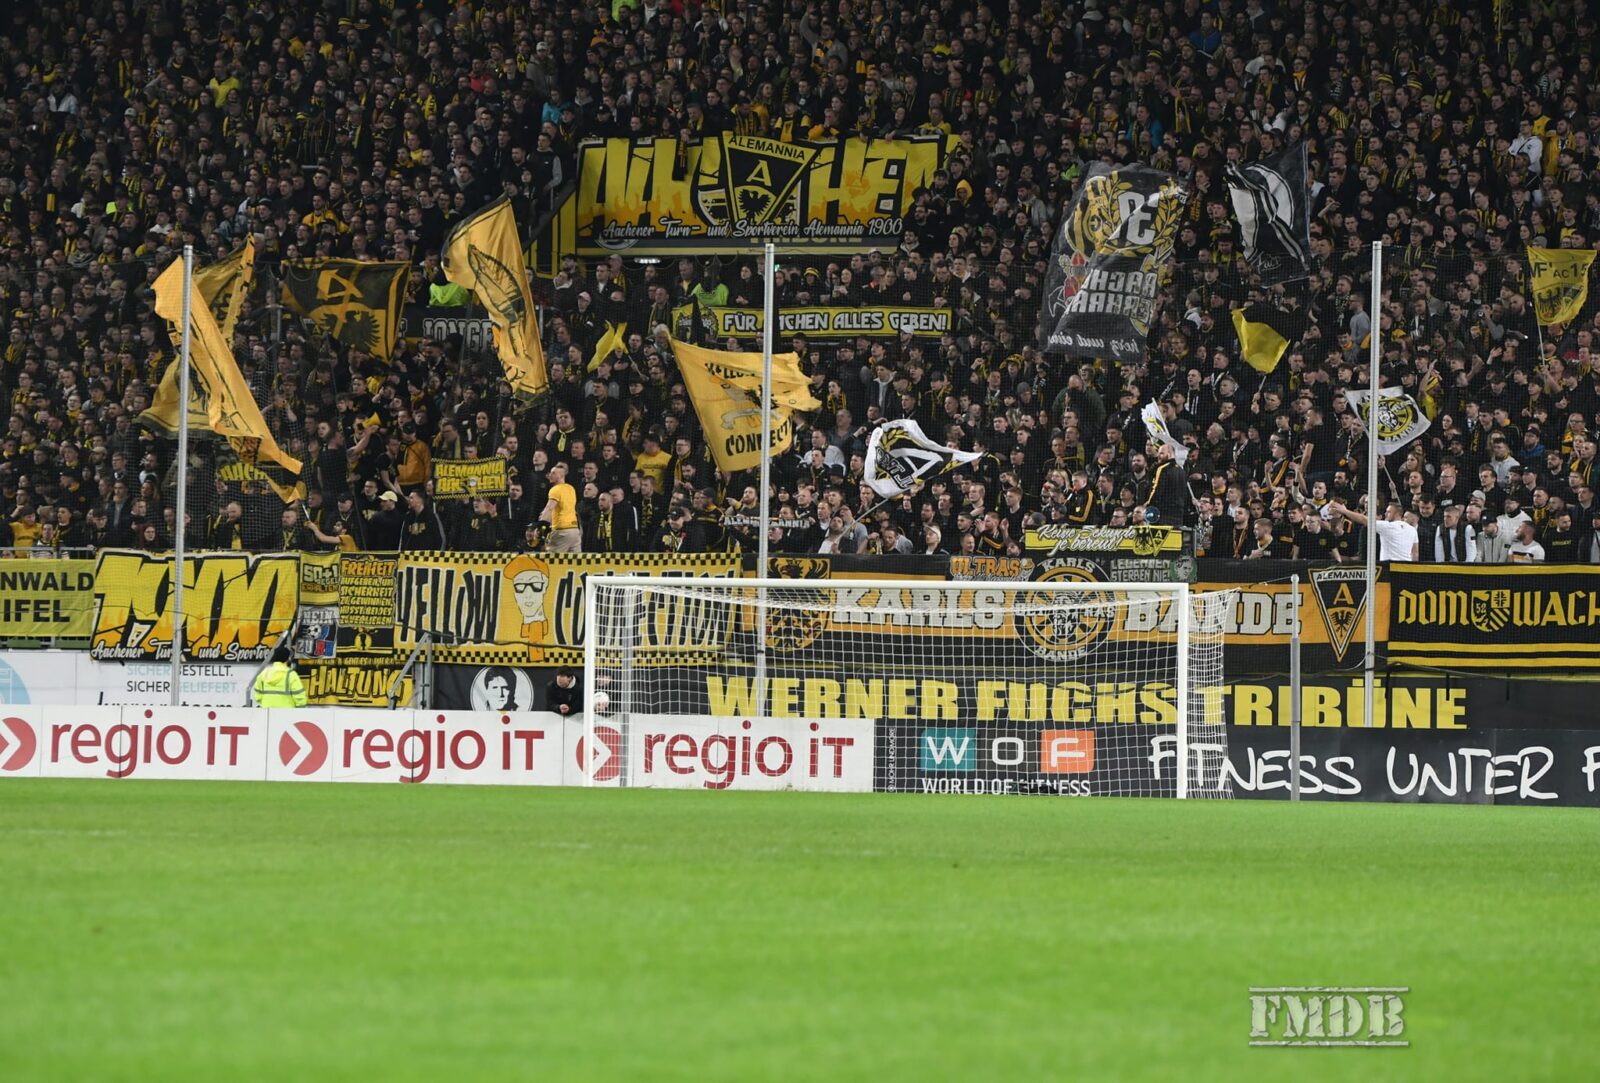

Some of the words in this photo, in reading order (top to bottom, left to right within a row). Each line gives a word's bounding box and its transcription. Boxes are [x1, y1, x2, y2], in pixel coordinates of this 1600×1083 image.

[728, 136, 806, 161] ALEMANNIA
[746, 159, 772, 187] A
[603, 220, 656, 238] Aachener
[659, 217, 700, 238] Turn-
[707, 221, 730, 238] und
[732, 219, 800, 240] Sportverein
[803, 218, 865, 237] Alemannia
[868, 217, 903, 236] 1900
[723, 311, 758, 331] FÜR
[832, 312, 884, 330] ALLES
[889, 312, 948, 331] GEBEN!
[1037, 525, 1075, 540] Keine
[1077, 525, 1136, 541] Sekunde
[341, 560, 395, 576] FREIHEIT
[951, 556, 1022, 577] ULTRAS
[1042, 557, 1097, 573] KARLS
[398, 566, 501, 644] YELLOW
[1333, 582, 1353, 605] A
[302, 610, 335, 625] NEIN
[831, 587, 1006, 629] KARLS
[91, 642, 145, 660] Aachener
[198, 642, 221, 659] und
[127, 664, 171, 676] SICHER
[126, 680, 171, 692] SICHER
[705, 676, 960, 721] WERNER
[976, 680, 1179, 725] FUCHS
[1190, 678, 1468, 730] TRIBÜNE
[51, 709, 192, 778] regio
[343, 714, 487, 784] regio
[643, 720, 794, 790] regio
[1148, 735, 1363, 795] FTNESS
[1386, 746, 1559, 799] UNTER
[921, 778, 986, 796] WORLD
[990, 778, 1013, 796] OF
